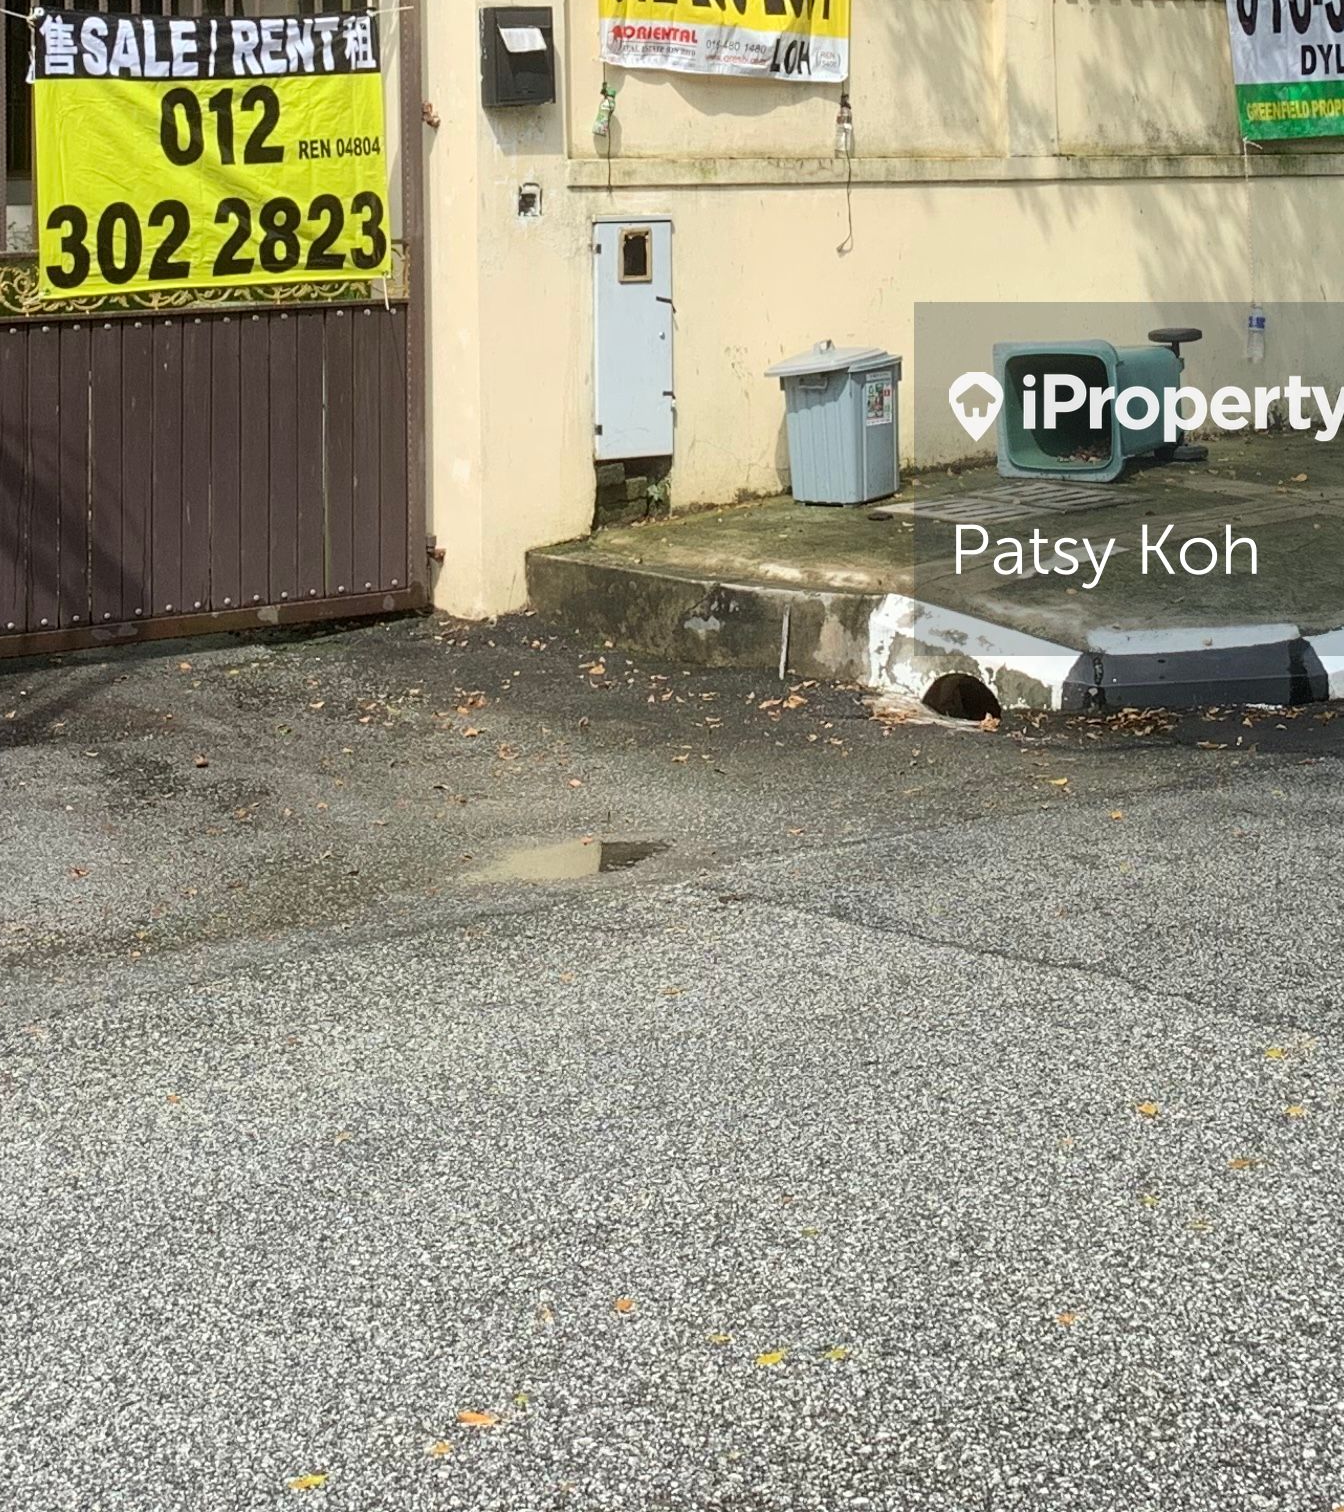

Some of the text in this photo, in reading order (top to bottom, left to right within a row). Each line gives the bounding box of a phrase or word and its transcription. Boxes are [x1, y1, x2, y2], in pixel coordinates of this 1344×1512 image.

[40, 16, 78, 75] 售
[80, 16, 198, 77] SALE
[231, 17, 340, 76] RENT
[343, 15, 377, 69] 租
[623, 25, 698, 43] ORIENTAL
[769, 38, 812, 75] LOH
[160, 84, 284, 167] 012
[298, 136, 380, 160] REN 04804
[46, 190, 387, 290] 302 2823
